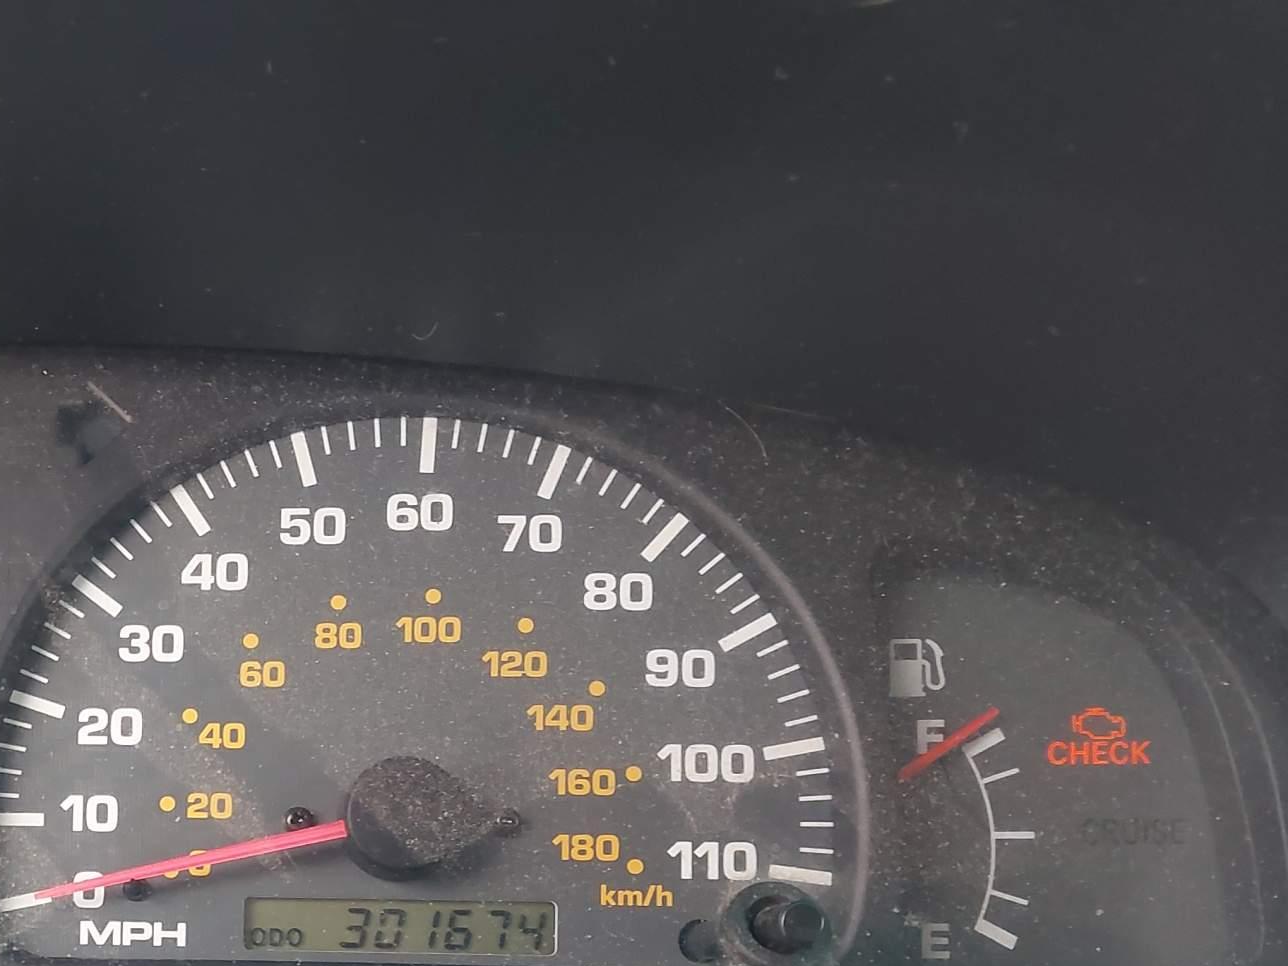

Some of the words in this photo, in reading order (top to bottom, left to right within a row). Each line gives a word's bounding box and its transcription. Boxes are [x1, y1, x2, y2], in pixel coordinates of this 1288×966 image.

[280, 508, 346, 545] 50
[387, 494, 453, 530] 60
[497, 515, 562, 552] 70
[181, 553, 248, 590] 40
[583, 573, 653, 610] 80
[119, 625, 183, 662] 30
[314, 623, 362, 648] 80
[396, 617, 461, 642] 100
[239, 661, 285, 687] 60
[482, 651, 547, 677] 120
[645, 649, 715, 687] 90
[78, 708, 142, 745] 20
[527, 705, 594, 730] 140
[199, 723, 245, 748] 40
[917, 720, 946, 754] F
[657, 744, 754, 782] 100
[1047, 741, 1151, 766] CHECK
[548, 769, 615, 795] 160
[60, 795, 118, 832] 10
[187, 793, 232, 818] 20
[552, 835, 620, 861] 180
[1081, 818, 1185, 846] CRUISE
[667, 842, 758, 880] 110
[73, 871, 105, 908] 0
[600, 885, 673, 907] km/h
[79, 921, 186, 946] MPH
[252, 927, 303, 947] ODO
[339, 907, 546, 951] 301674
[921, 923, 951, 959] E
